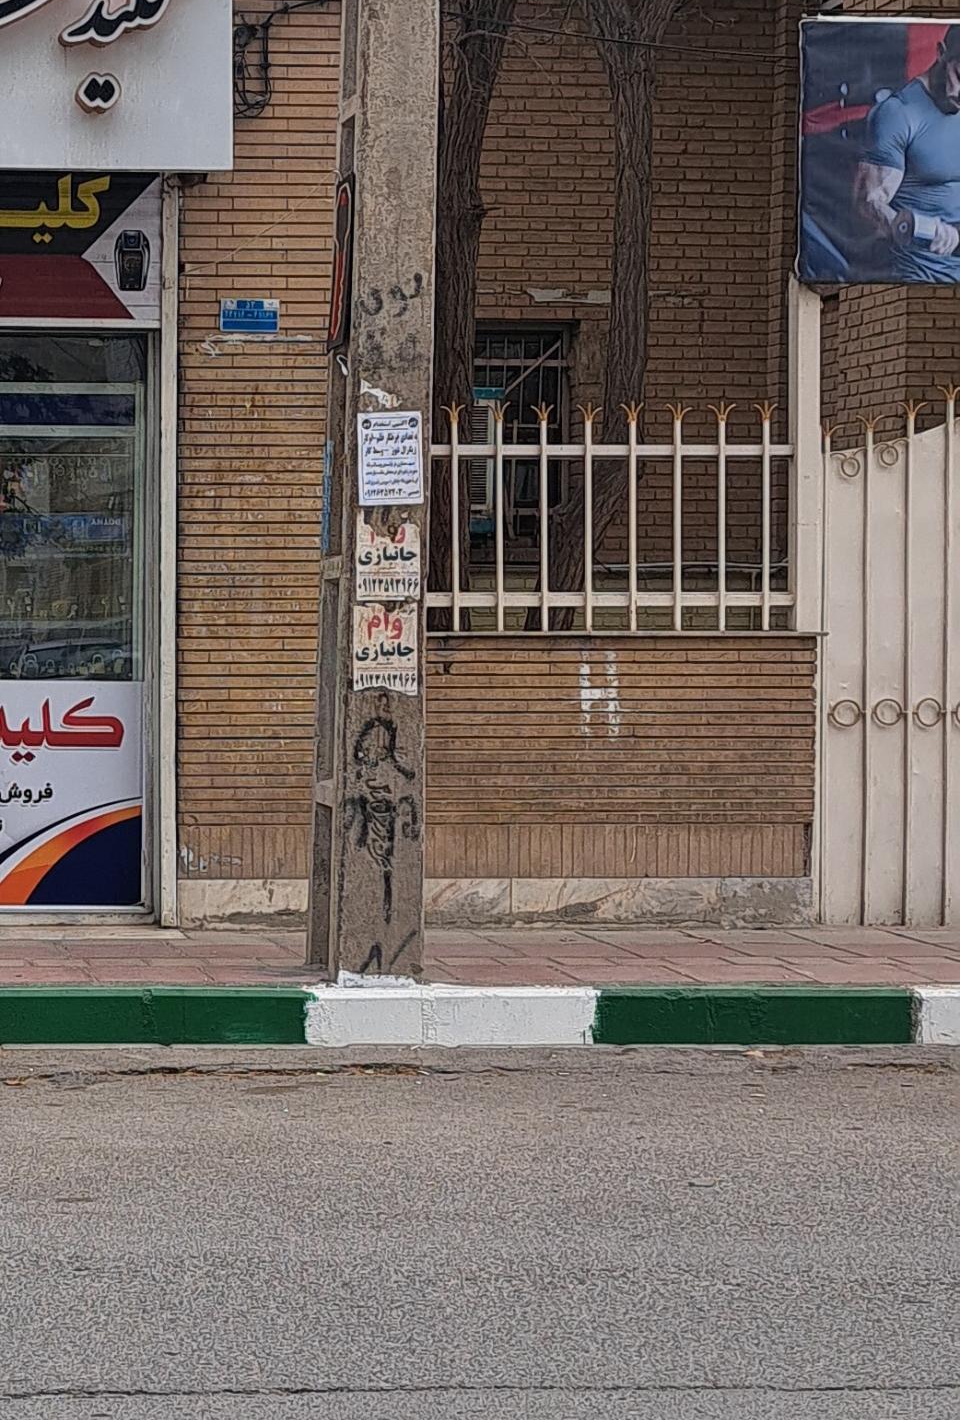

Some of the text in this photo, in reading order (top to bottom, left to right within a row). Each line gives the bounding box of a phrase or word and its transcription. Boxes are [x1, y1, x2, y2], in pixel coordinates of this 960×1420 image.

[357, 545, 418, 567] جانبازی
[367, 611, 403, 641] وام
[355, 641, 415, 662] جانبازی
